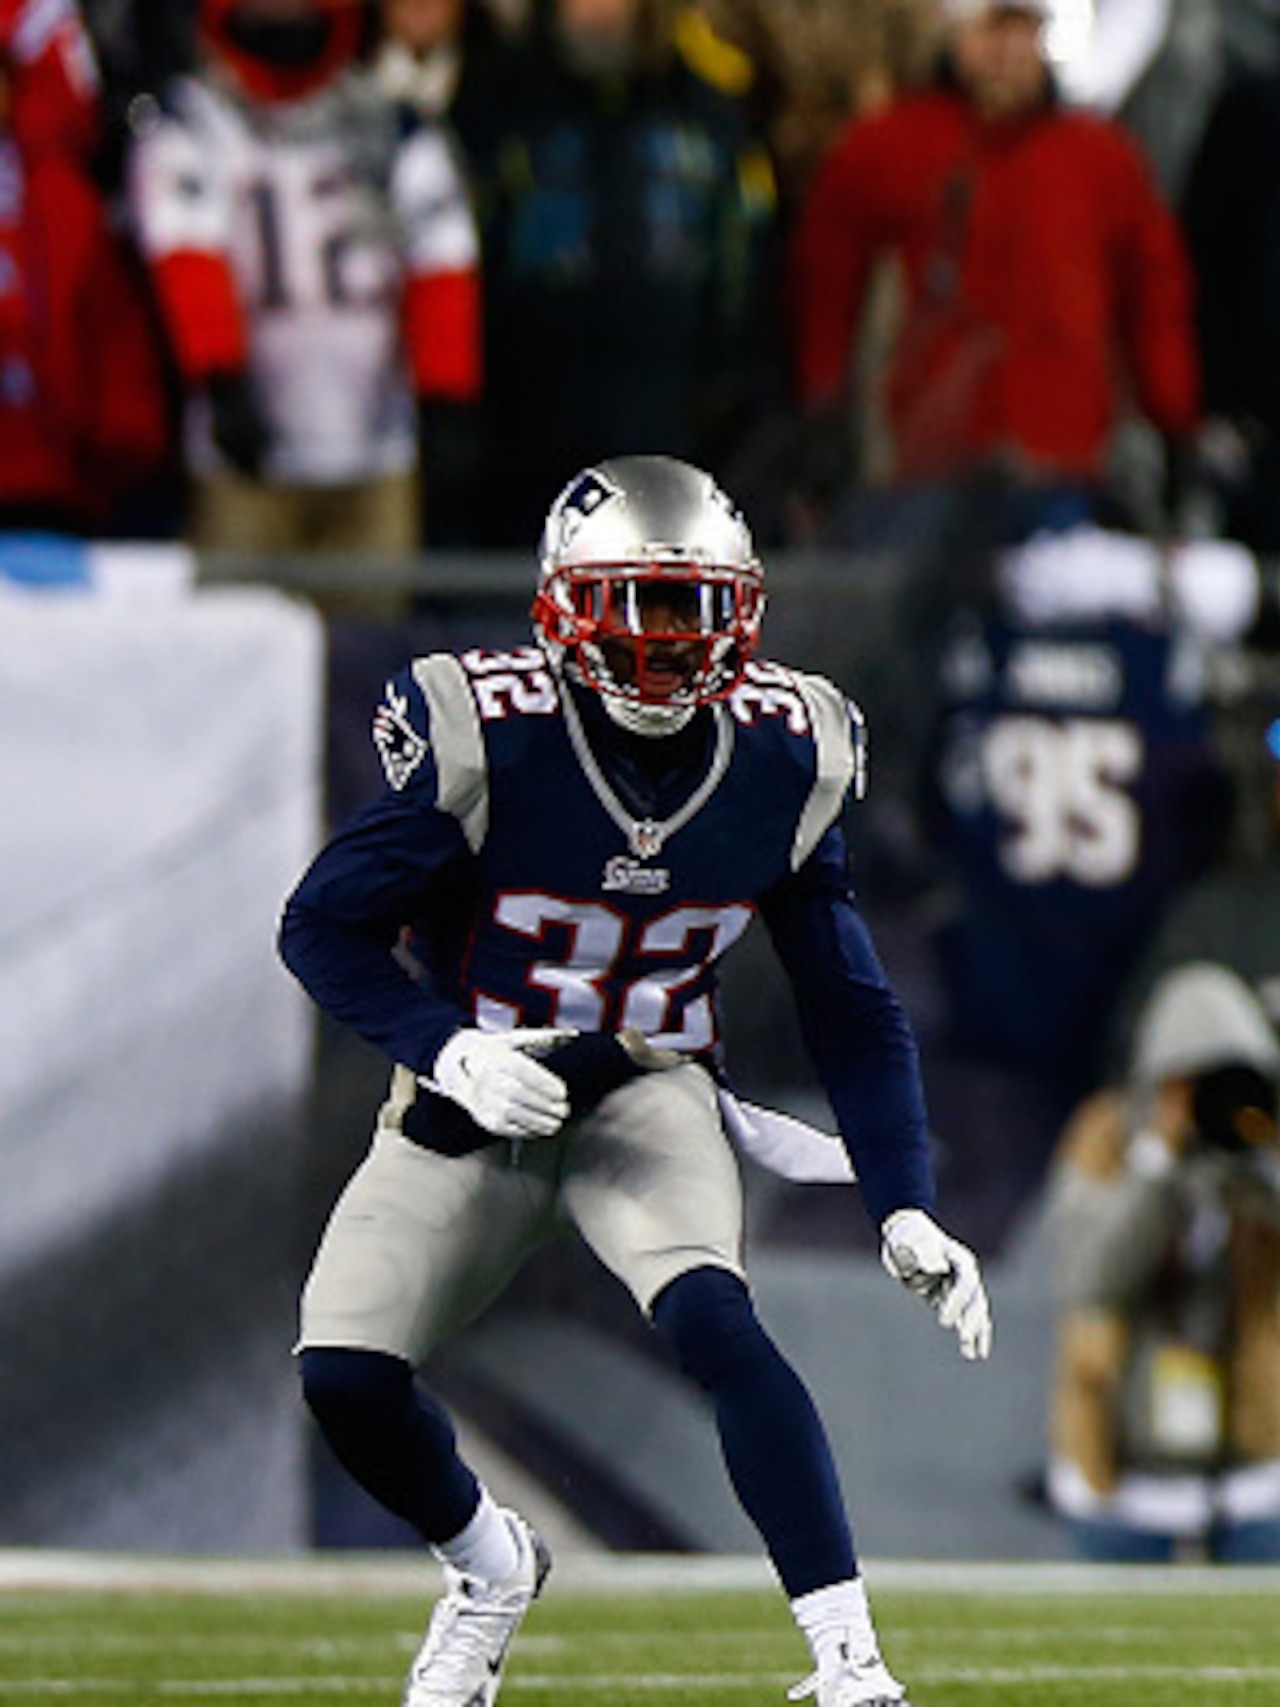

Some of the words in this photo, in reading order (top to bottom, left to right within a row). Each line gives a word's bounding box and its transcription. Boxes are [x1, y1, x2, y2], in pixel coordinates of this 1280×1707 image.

[244, 168, 401, 310] 12
[460, 646, 560, 722] 32
[981, 712, 1144, 886] 95
[470, 888, 757, 1054] 32
